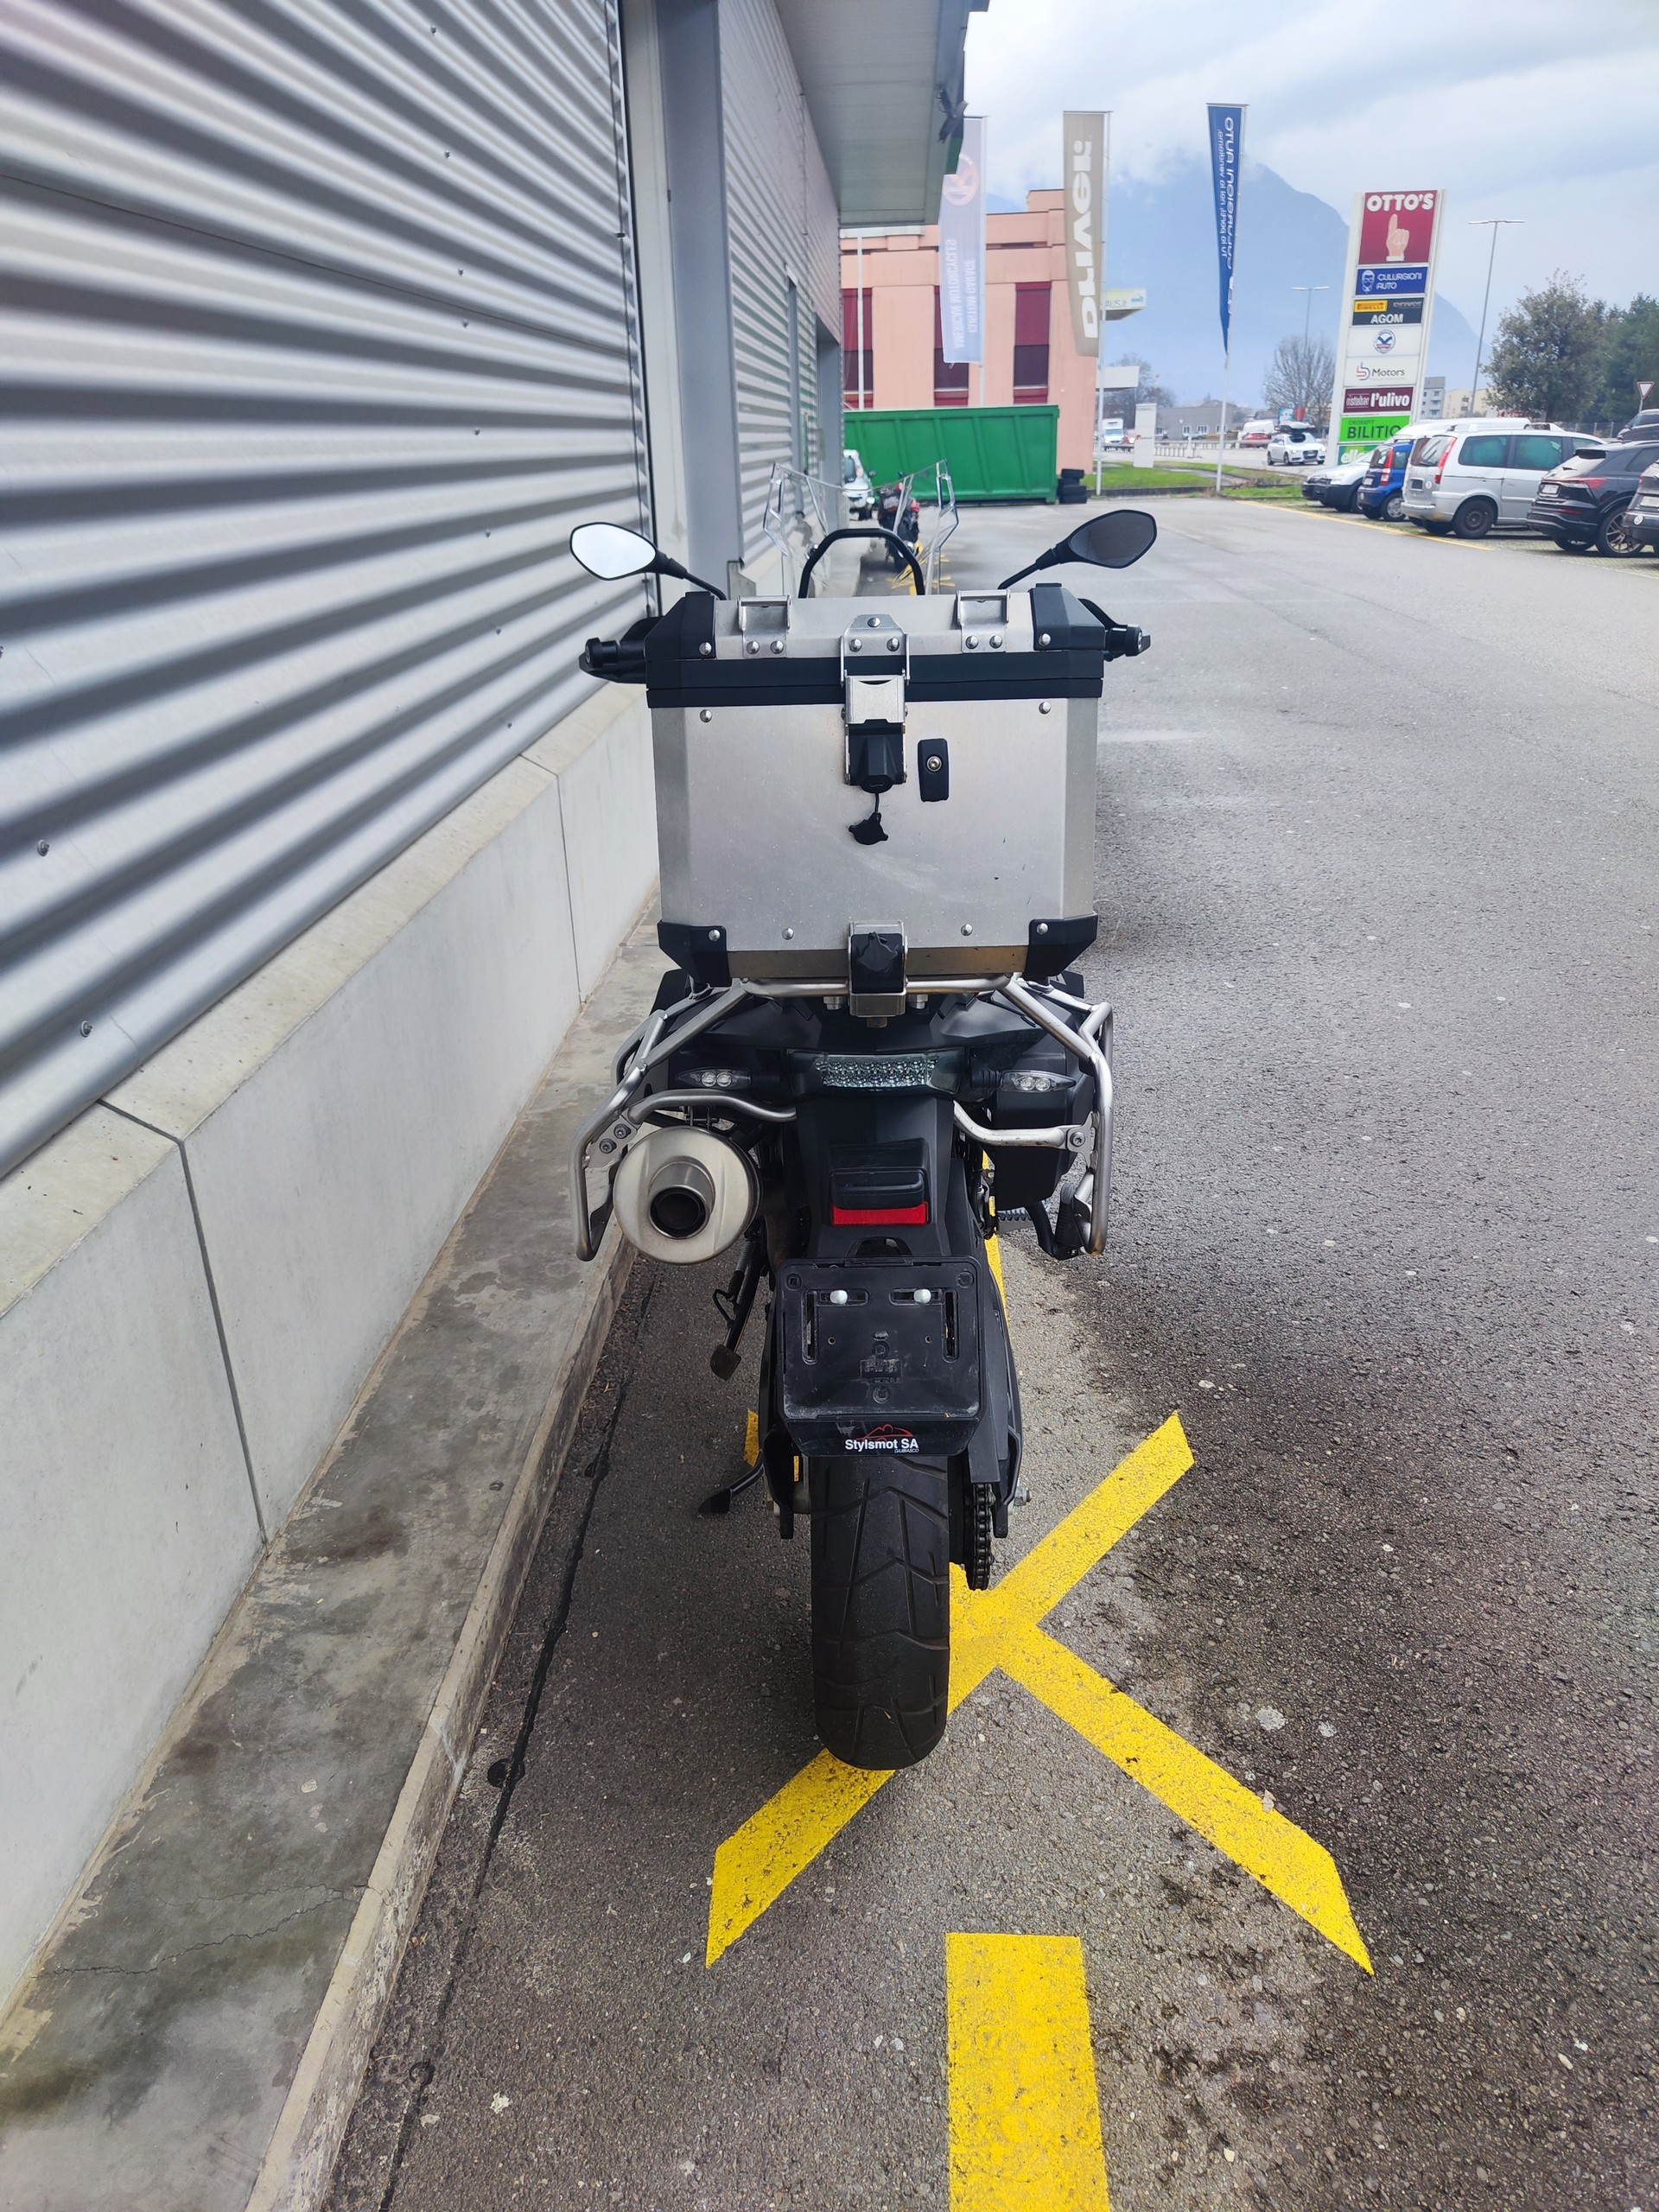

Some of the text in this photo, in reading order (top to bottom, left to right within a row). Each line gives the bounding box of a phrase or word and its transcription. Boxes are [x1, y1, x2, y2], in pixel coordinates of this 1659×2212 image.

[1367, 194, 1434, 212] OTTO'S
[1376, 282, 1398, 290] AUTO
[1370, 314, 1404, 324] AGOM
[1371, 368, 1406, 378] Motors
[1370, 391, 1410, 408] l'ulivo
[845, 1438, 919, 1452] Stylsmot SA
